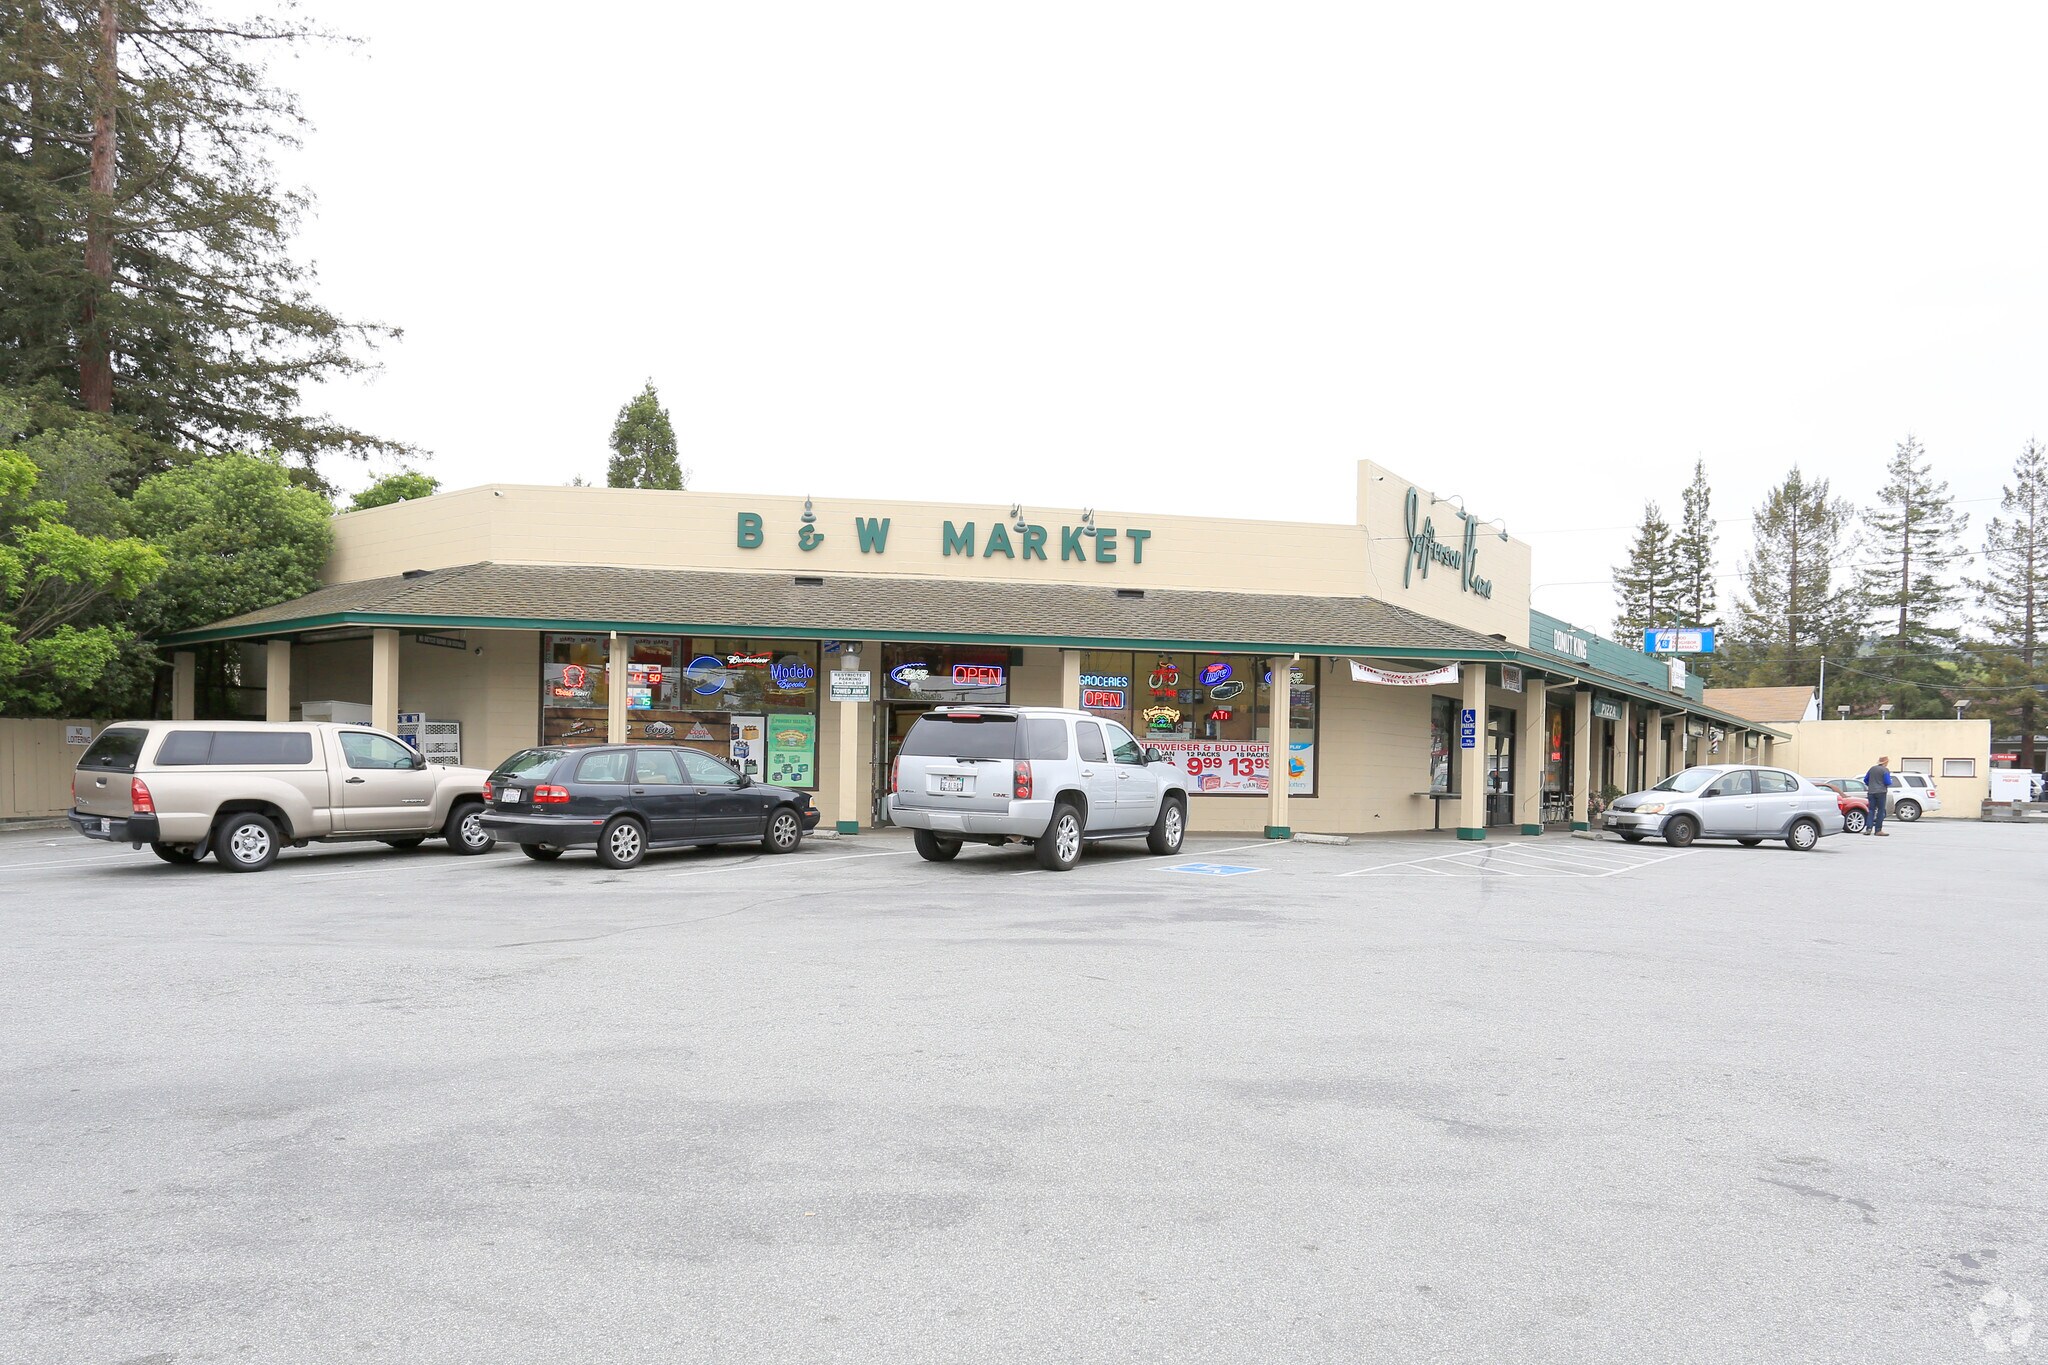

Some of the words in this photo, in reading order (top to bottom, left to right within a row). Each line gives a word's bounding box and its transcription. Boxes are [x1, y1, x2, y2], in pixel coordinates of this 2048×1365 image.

[737, 512, 764, 549] B
[798, 524, 824, 551] &
[856, 517, 890, 553] W
[943, 520, 1151, 564] MARKET
[1403, 486, 1462, 590] Jefferson
[1461, 514, 1493, 600] Plaza
[1553, 629, 1573, 655] DONUT
[1573, 635, 1587, 660] KING
[727, 655, 771, 664] Budweiser
[649, 674, 661, 682] 50
[770, 663, 814, 681] Modelo
[954, 666, 1000, 685] OPEN
[1358, 665, 1379, 675] FINE
[1383, 672, 1413, 680] WINES
[1079, 675, 1128, 687] GROCERIES
[1084, 691, 1120, 707] OPEN
[1600, 703, 1616, 718] PIZZA
[645, 724, 675, 735] Coors
[1140, 743, 1200, 752] BUDWEISER
[1203, 744, 1212, 752] &
[1215, 744, 1237, 752] BUD
